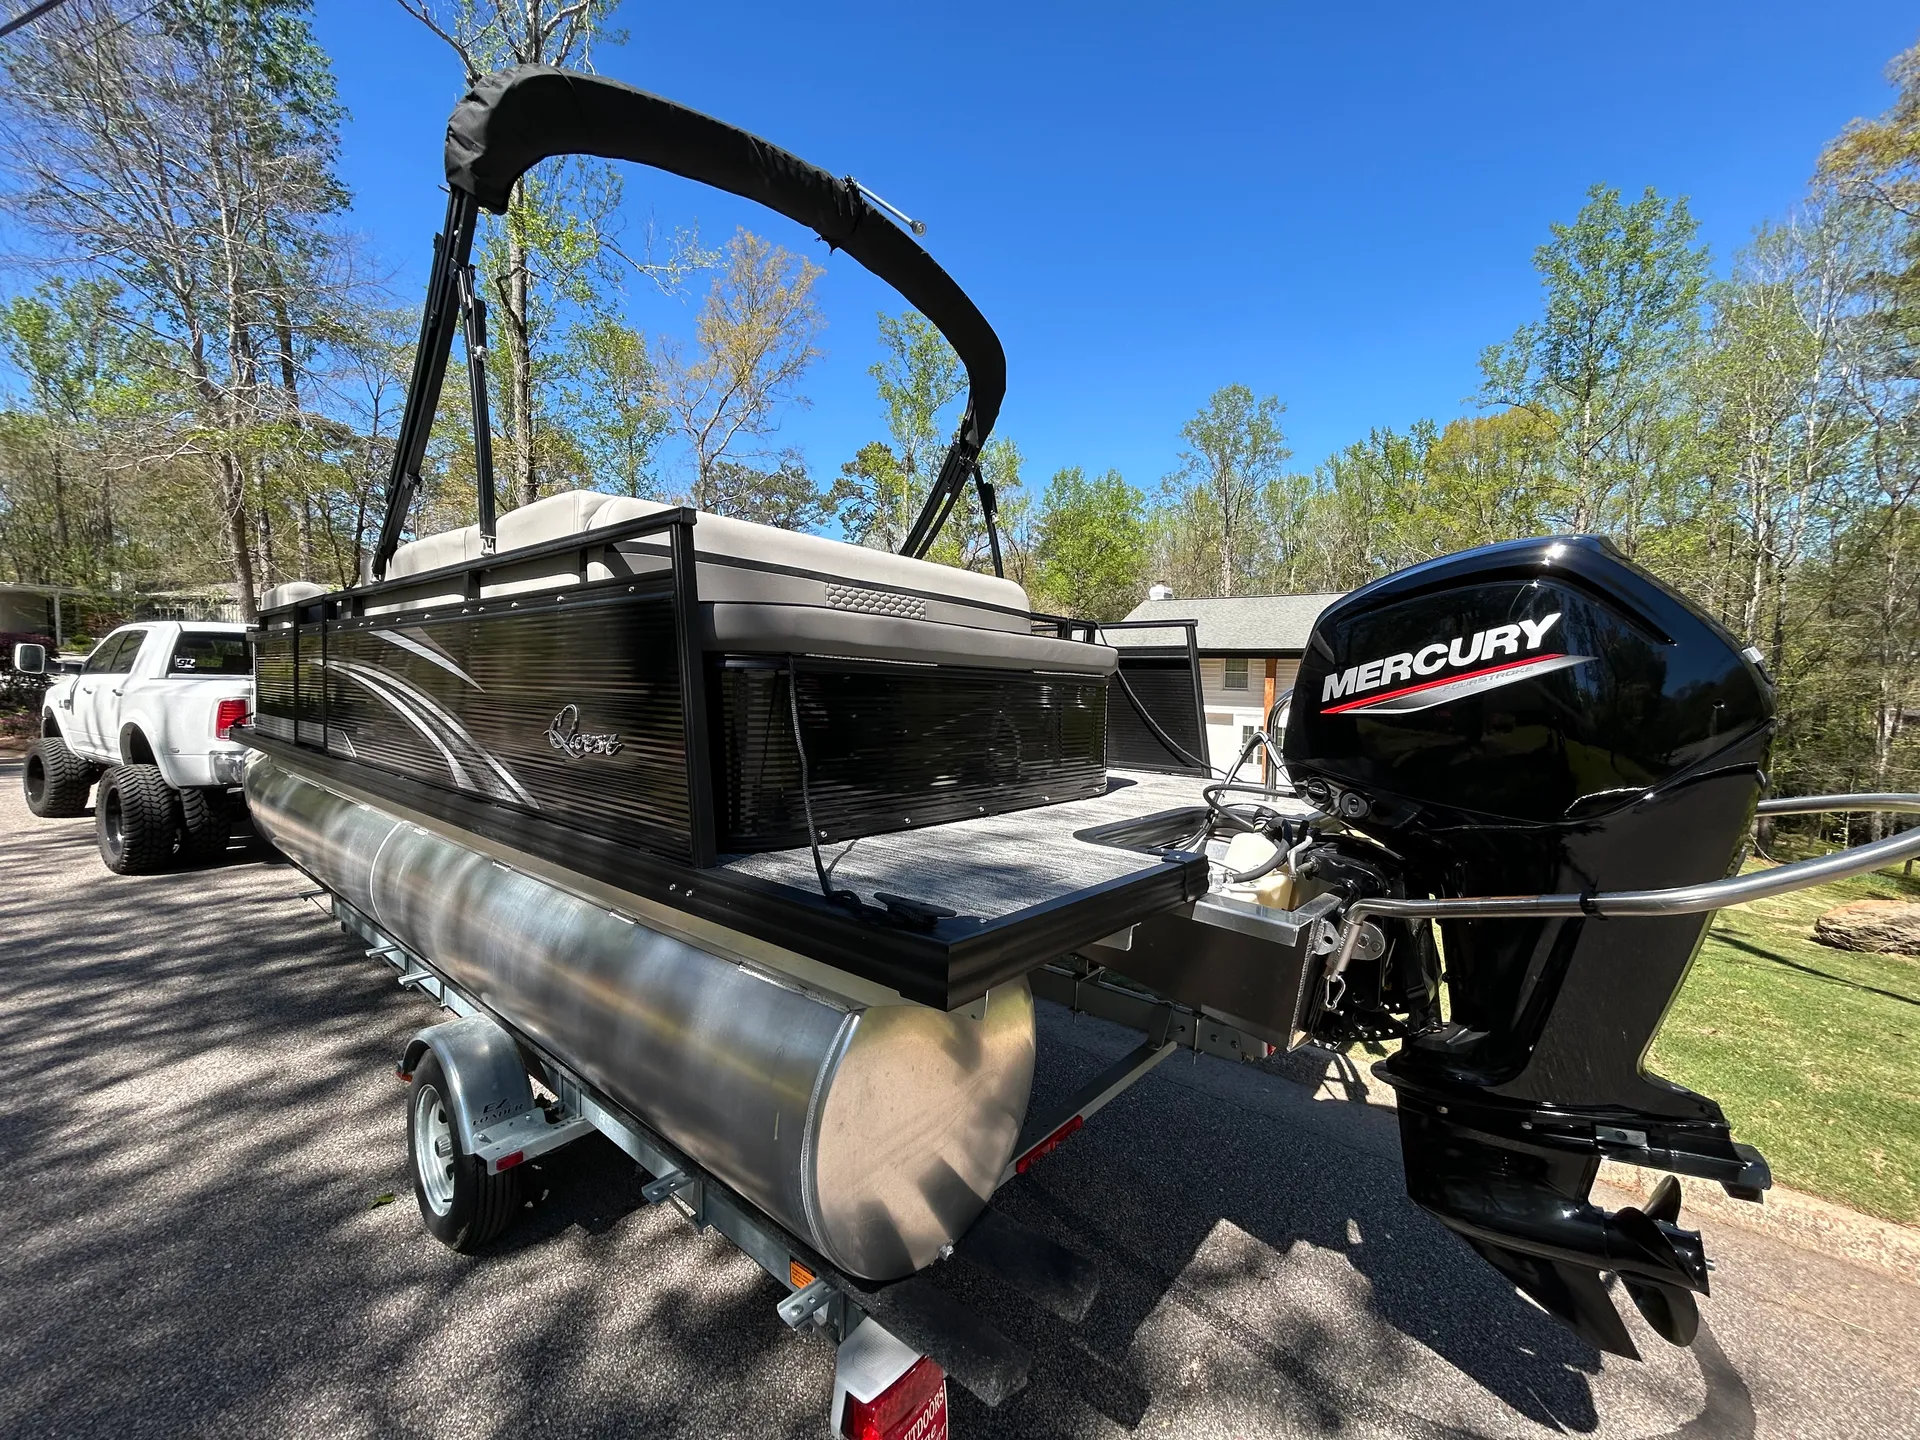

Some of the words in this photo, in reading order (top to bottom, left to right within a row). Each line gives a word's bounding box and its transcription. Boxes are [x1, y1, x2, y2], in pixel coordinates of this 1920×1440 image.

[1321, 612, 1562, 703] MERCURY
[1441, 666, 1534, 693] FOURSTROKE
[542, 704, 622, 759] Quest
[473, 1103, 523, 1126] LOADER
